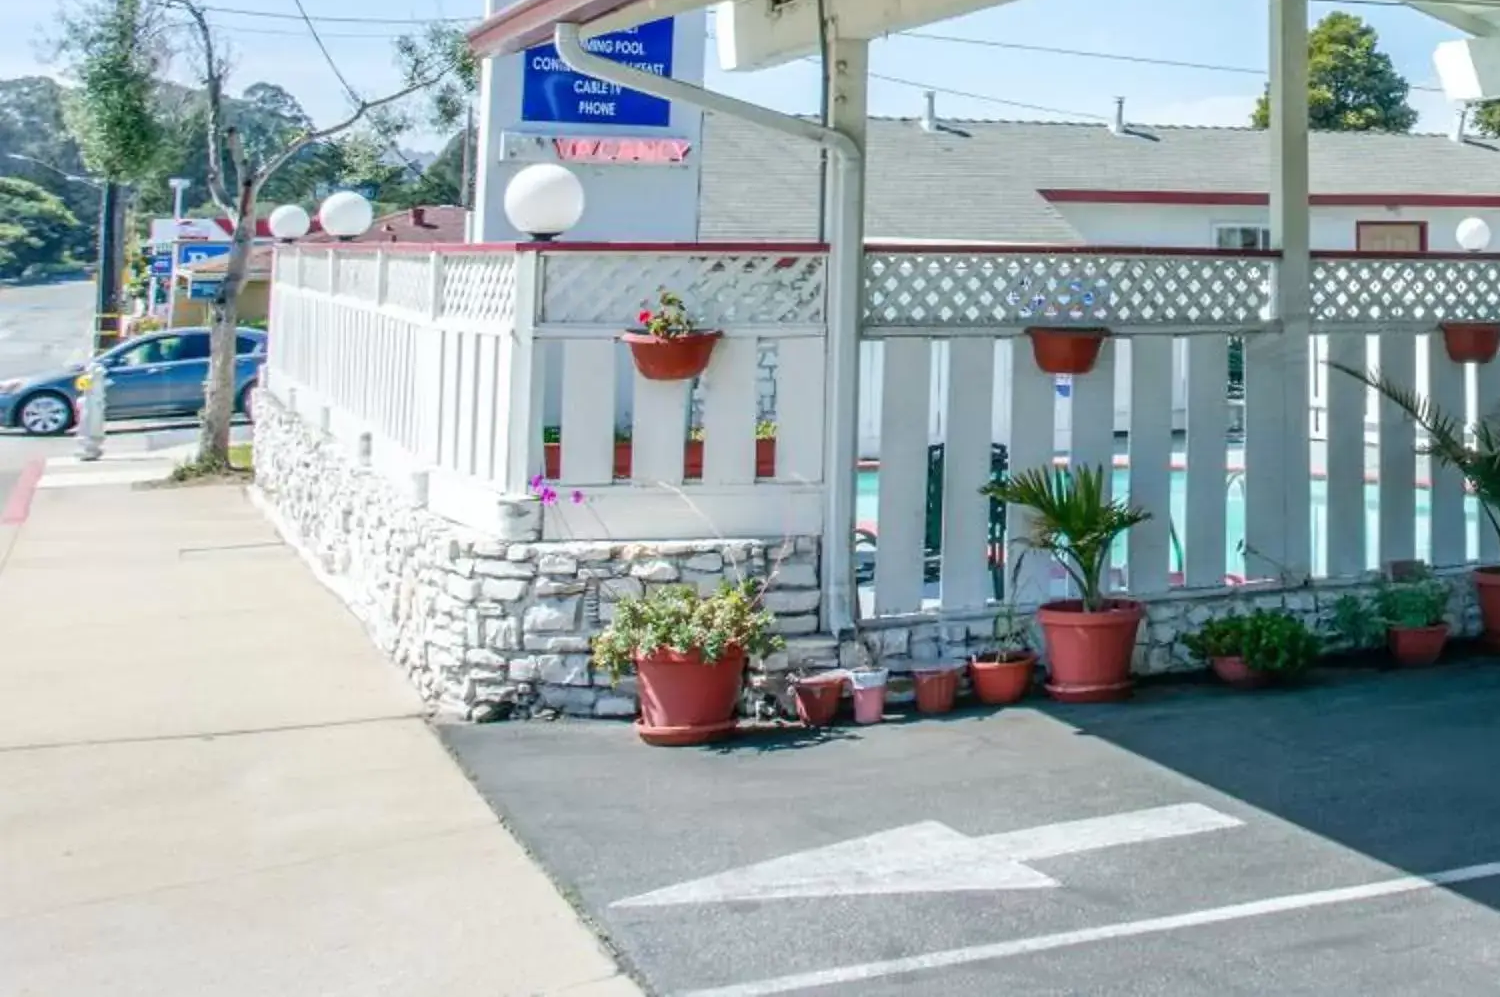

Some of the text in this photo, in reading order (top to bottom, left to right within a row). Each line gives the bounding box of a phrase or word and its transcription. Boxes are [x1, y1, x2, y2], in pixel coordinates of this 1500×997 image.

[616, 40, 645, 55] POOL
[573, 80, 608, 94] CABLE
[578, 100, 616, 116] PHONE
